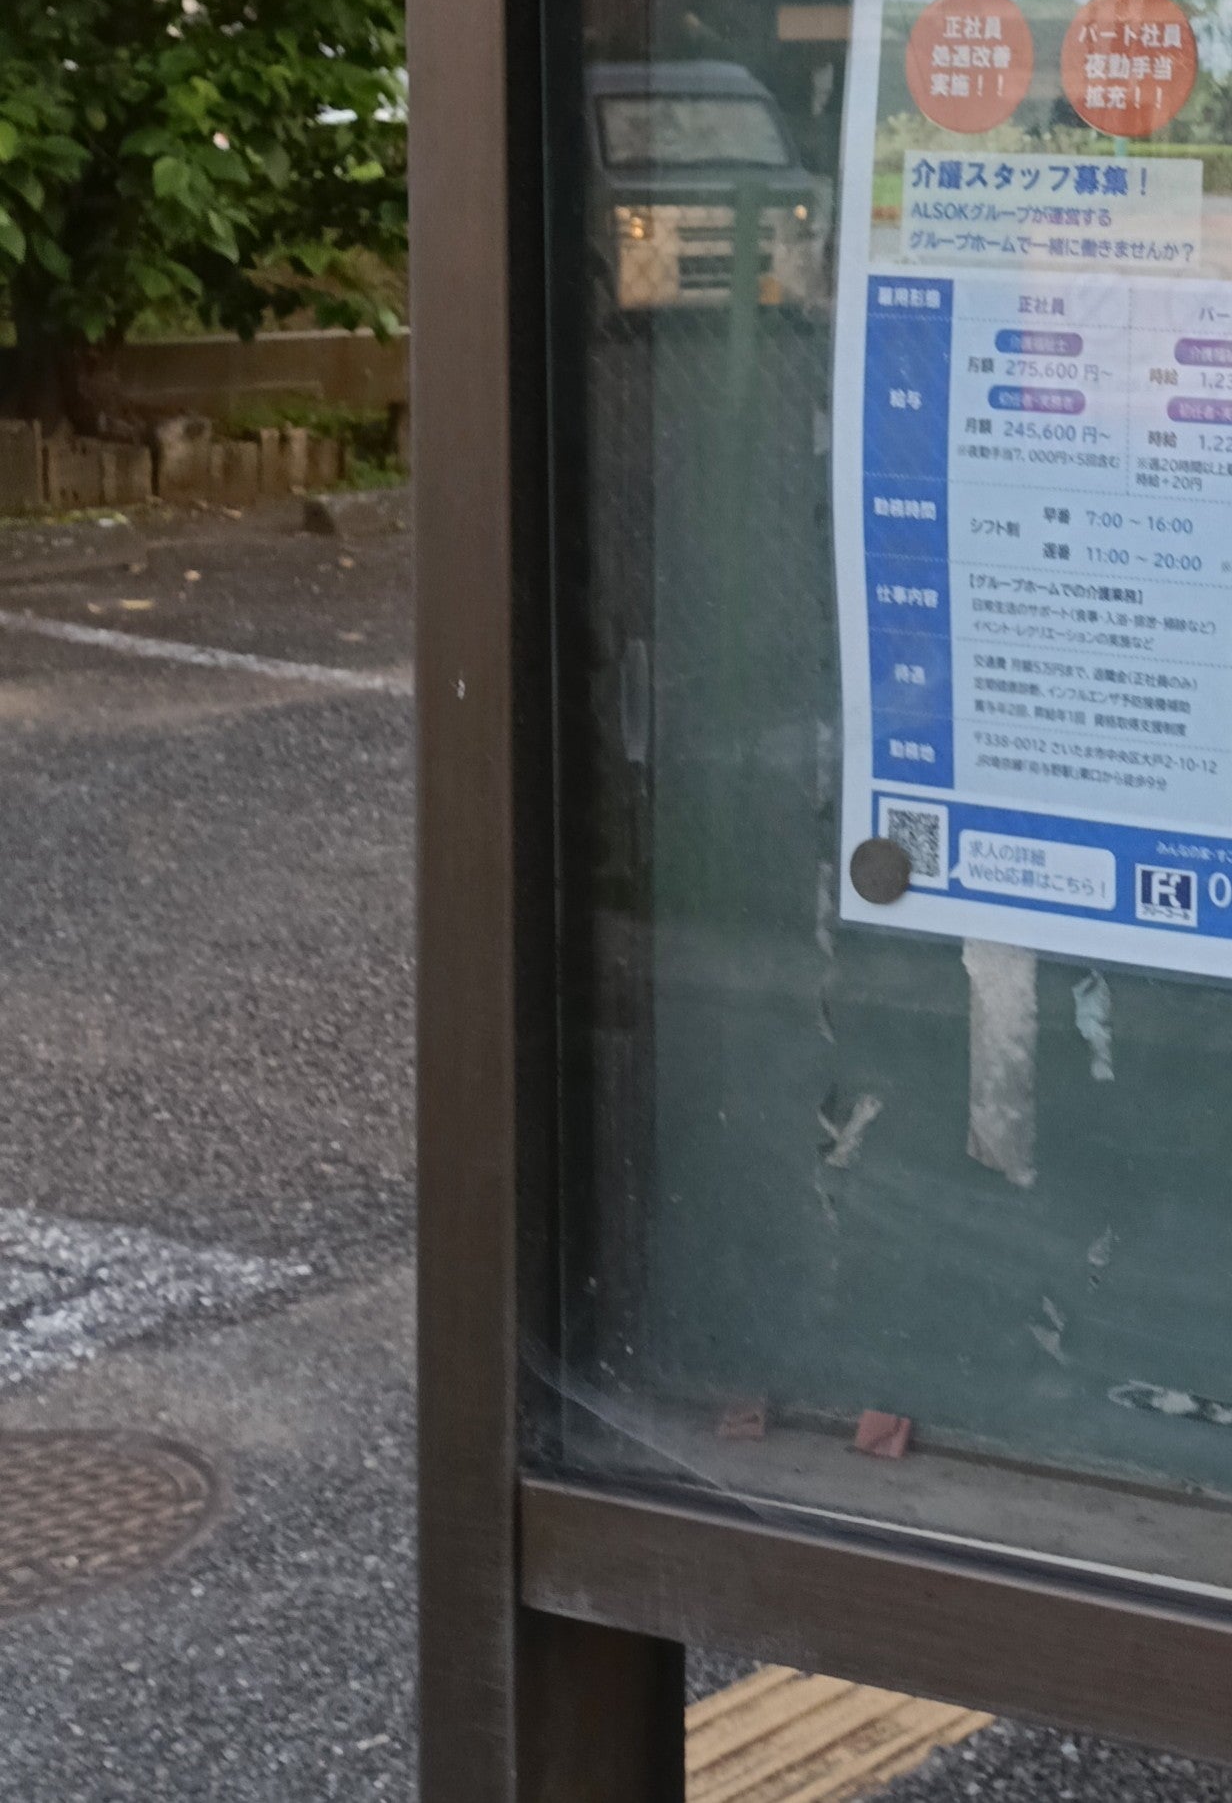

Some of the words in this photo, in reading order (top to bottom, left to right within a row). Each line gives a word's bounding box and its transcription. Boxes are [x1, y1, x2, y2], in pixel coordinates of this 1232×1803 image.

[942, 15, 1003, 41] 正社員
[1078, 23, 1182, 48] パート社員
[931, 44, 1012, 70] 処遇改善
[1085, 54, 1174, 81] 夜勤手当
[910, 158, 1149, 196] 介護スタッフ募集！
[910, 202, 1113, 227] ALSOKグループが運営する
[1016, 295, 1066, 316] 正社員
[1149, 368, 1179, 387] 時給
[1148, 430, 1178, 449] 時給
